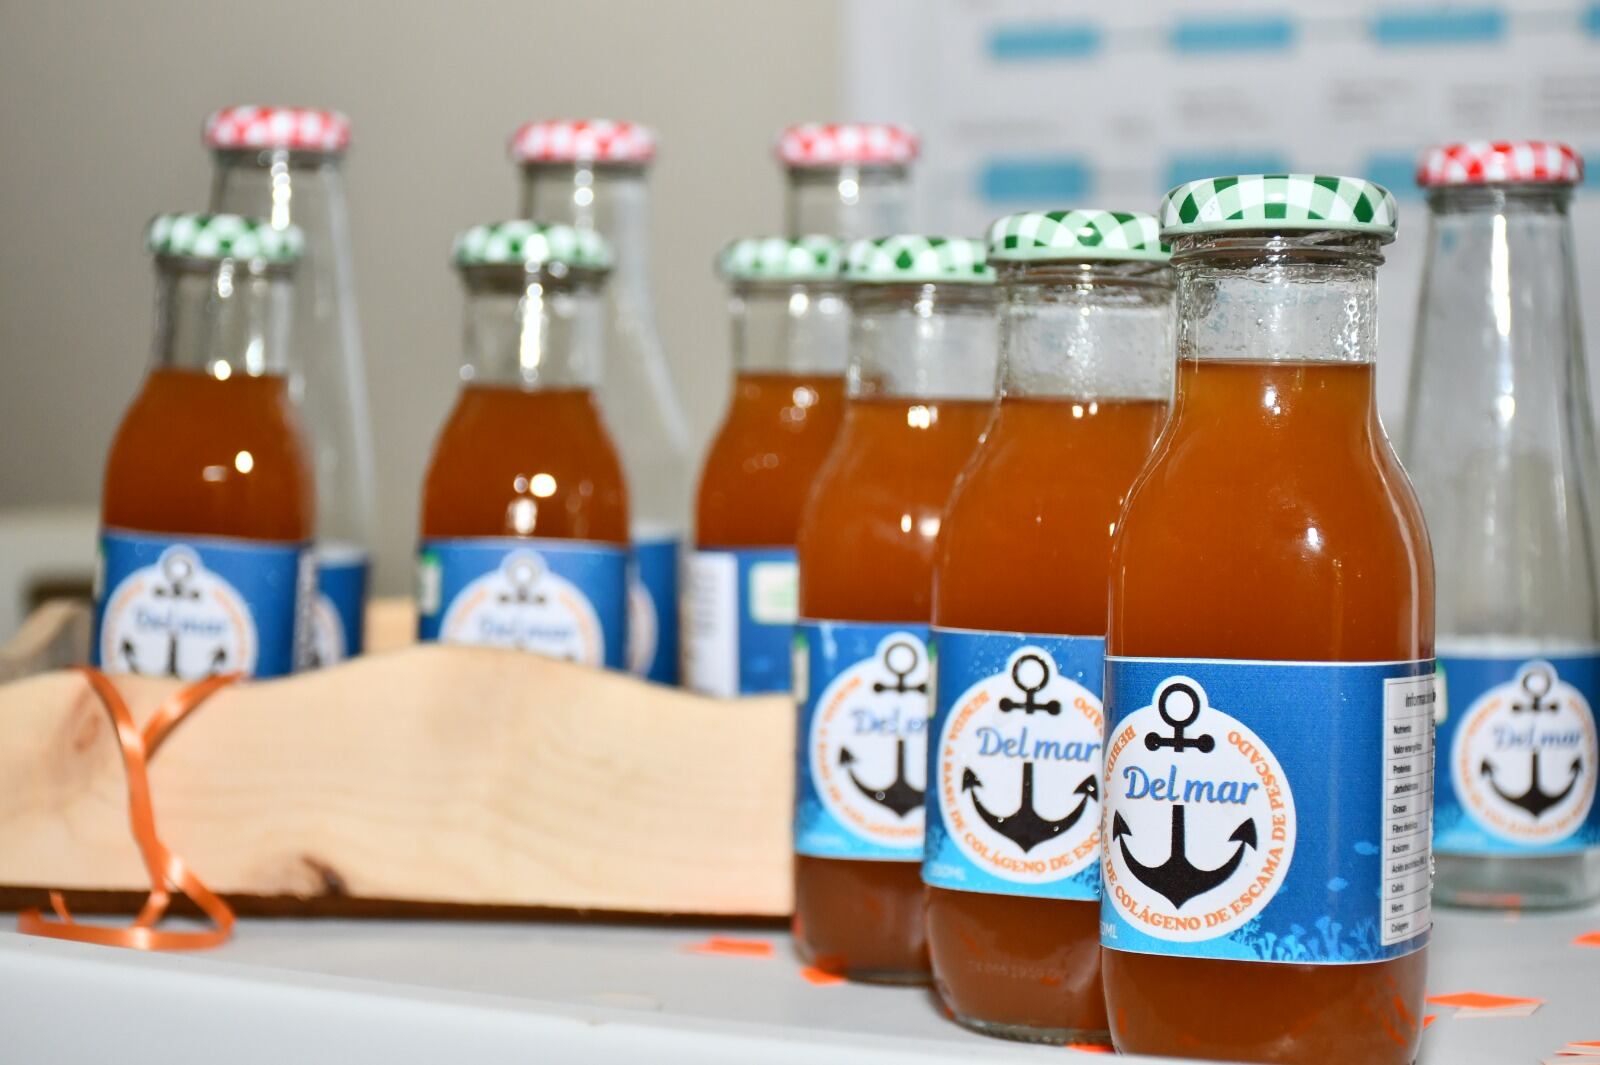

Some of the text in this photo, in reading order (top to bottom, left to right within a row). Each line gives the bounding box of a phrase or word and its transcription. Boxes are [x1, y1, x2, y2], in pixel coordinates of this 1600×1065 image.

[1104, 725, 1136, 782] BEBIDA
[1228, 731, 1286, 811] PESCADO
[1272, 814, 1287, 841] DE
[1050, 853, 1074, 872] DE
[1106, 859, 1118, 886] DE
[1231, 847, 1284, 914] ESCAMA
[1115, 885, 1202, 931] COLÁGENO
[1204, 908, 1231, 929] DE
